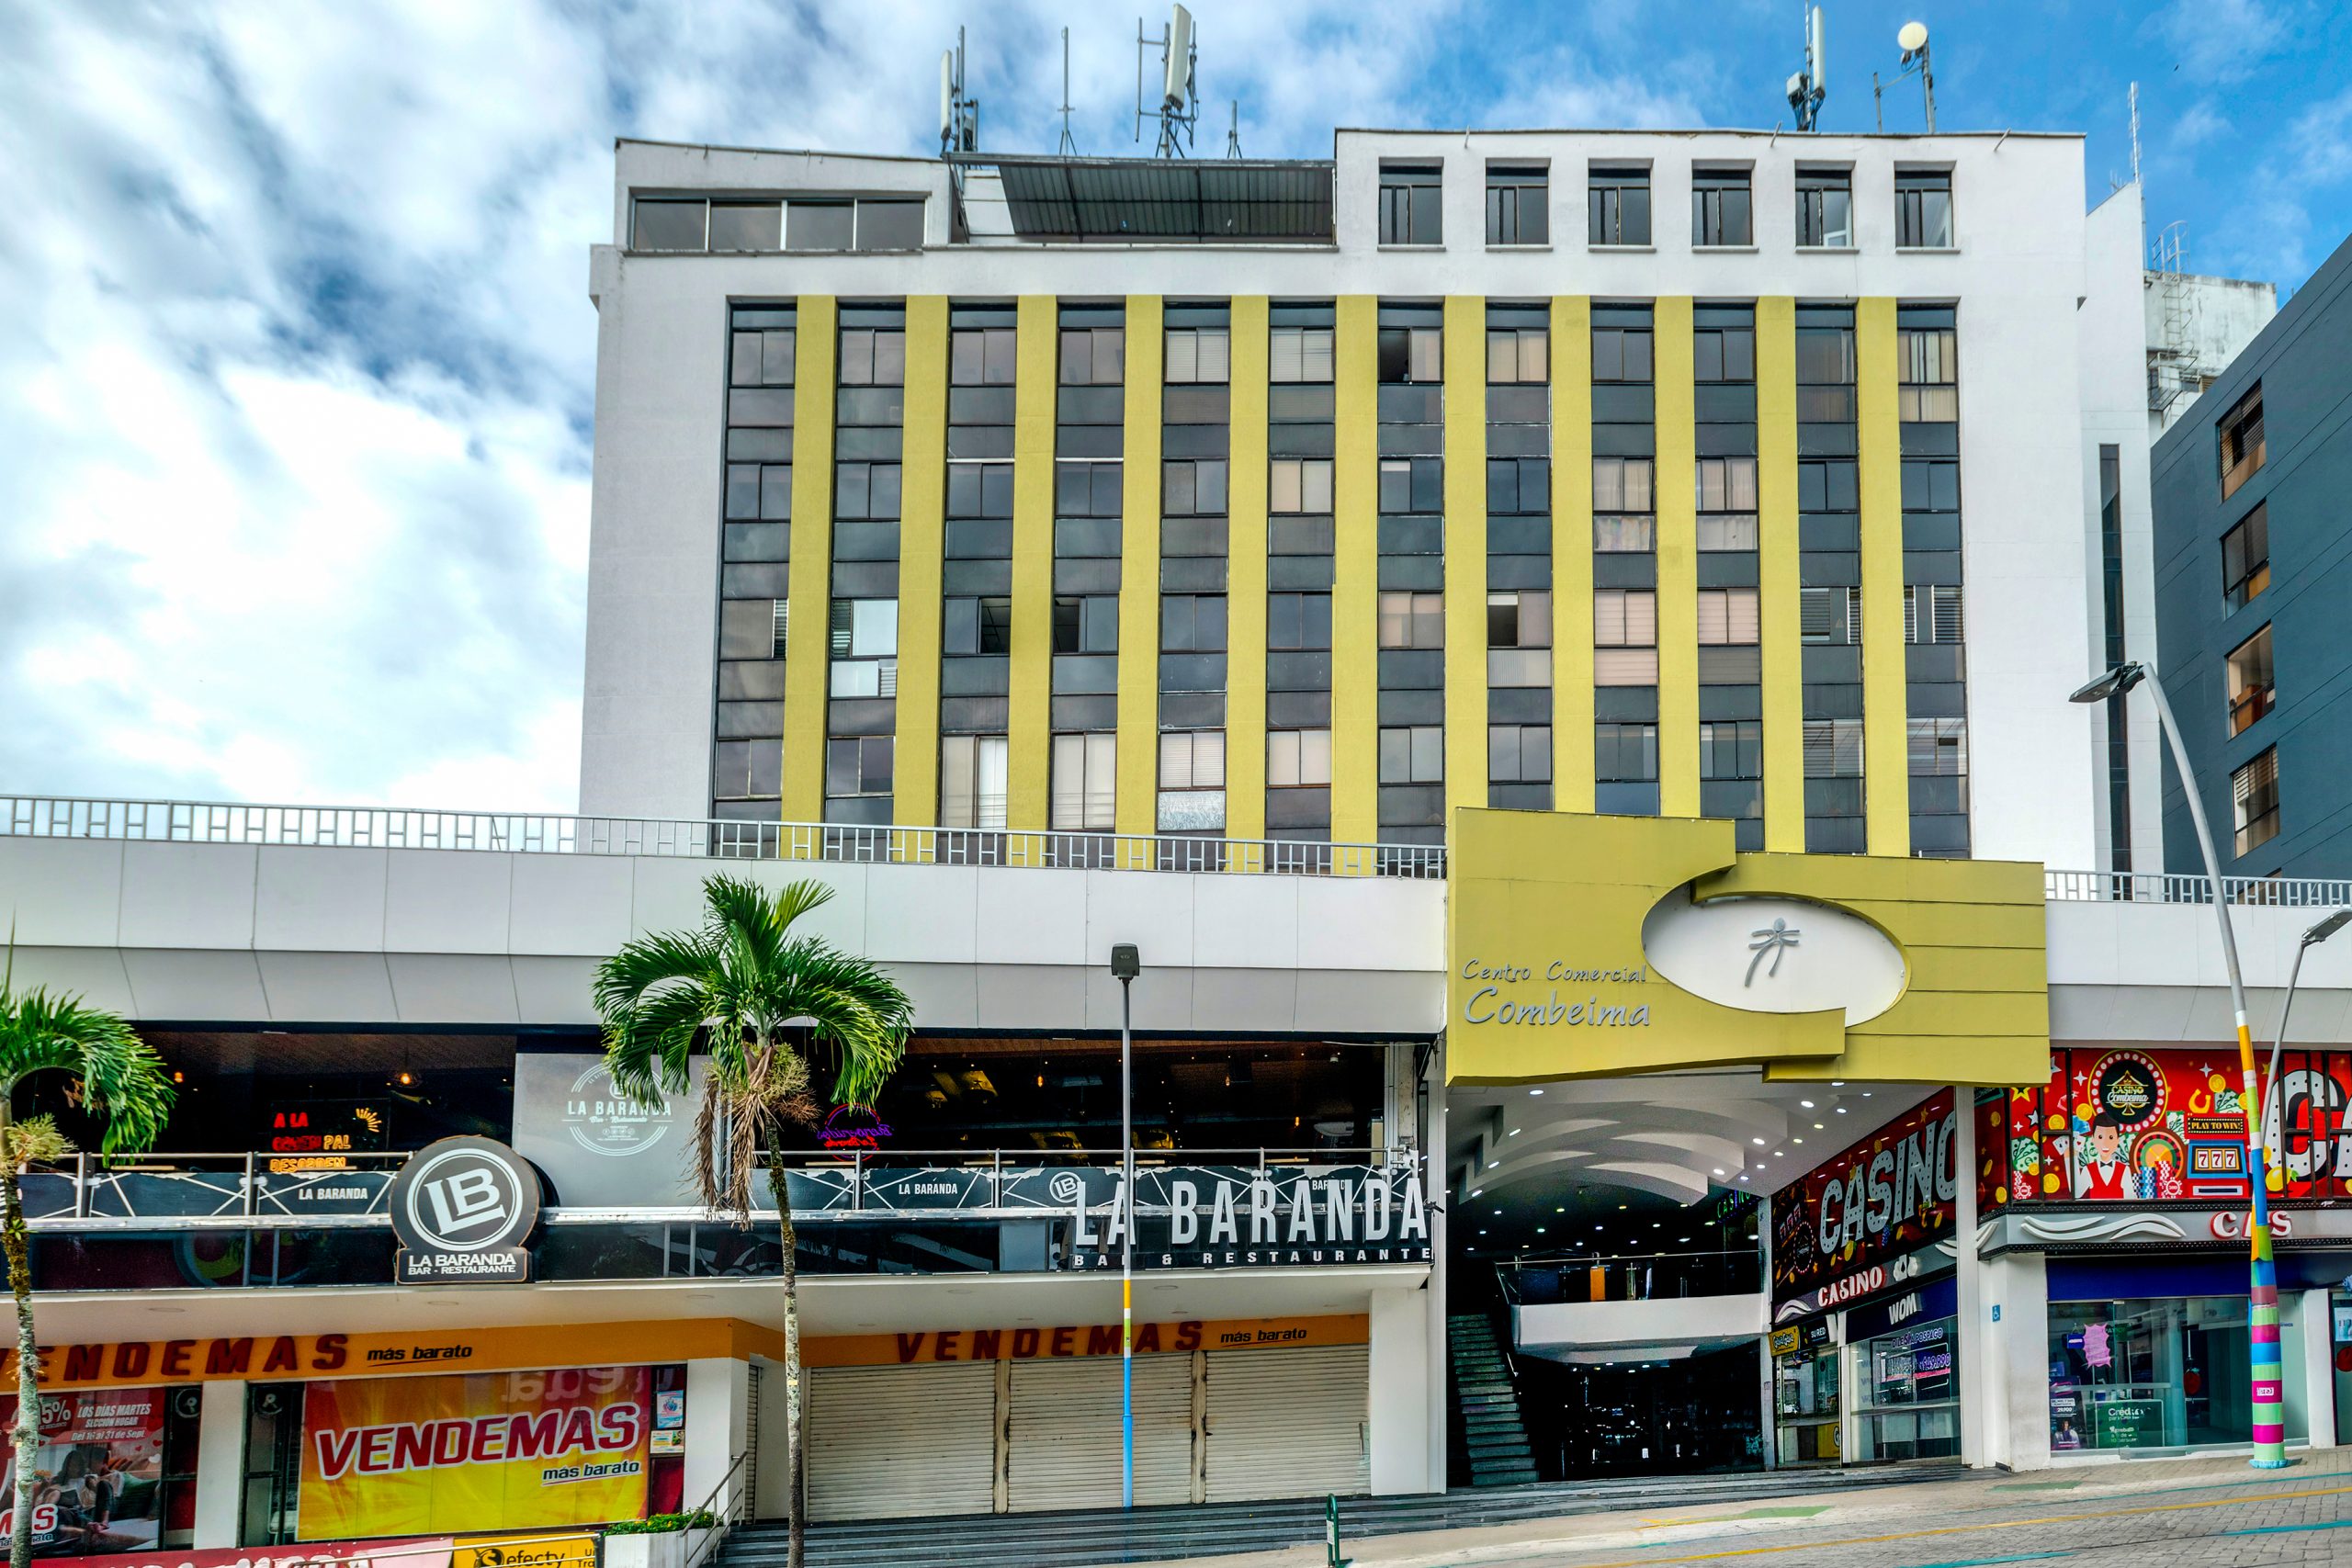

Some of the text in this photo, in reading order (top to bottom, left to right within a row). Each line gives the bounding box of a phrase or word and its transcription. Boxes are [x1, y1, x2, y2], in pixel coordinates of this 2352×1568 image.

[1462, 958, 1646, 983] Centro Comercial
[1464, 986, 1650, 1026] Combeima
[2108, 1091, 2150, 1102] Combeima
[2111, 1086, 2144, 1094] CASINO
[568, 1101, 586, 1115] LA
[274, 1112, 309, 1128] A LA
[2191, 1122, 2241, 1130] PLAY TO WIN!
[323, 1134, 351, 1150] PAL
[2199, 1153, 2234, 1166] 7 7 7
[299, 1188, 368, 1201] LA BARANDA
[899, 1183, 957, 1195] LA BARANDA
[424, 1168, 507, 1236] LB
[1076, 1179, 1428, 1245] LA BARANDA
[409, 1253, 516, 1268] LA BARANDA
[1074, 1248, 1431, 1267] BA & RESTAURANTE
[408, 1267, 431, 1275] BAR
[441, 1264, 516, 1275] RESTAURANTE
[1816, 1265, 1885, 1308] CASINO
[1889, 1292, 1918, 1325] WOM
[897, 1321, 1307, 1363] VENDEMAS más barato
[0, 1333, 472, 1382] ENDEMAS más barato
[77, 1403, 153, 1418] LOS DÍAS MARTES
[115, 1416, 139, 1427] HOGAR
[72, 1432, 85, 1441] Del
[114, 1429, 125, 1438] de
[317, 1404, 640, 1479] VENDEMAS
[542, 1461, 639, 1480] más barato
[506, 1551, 565, 1568] efecty
